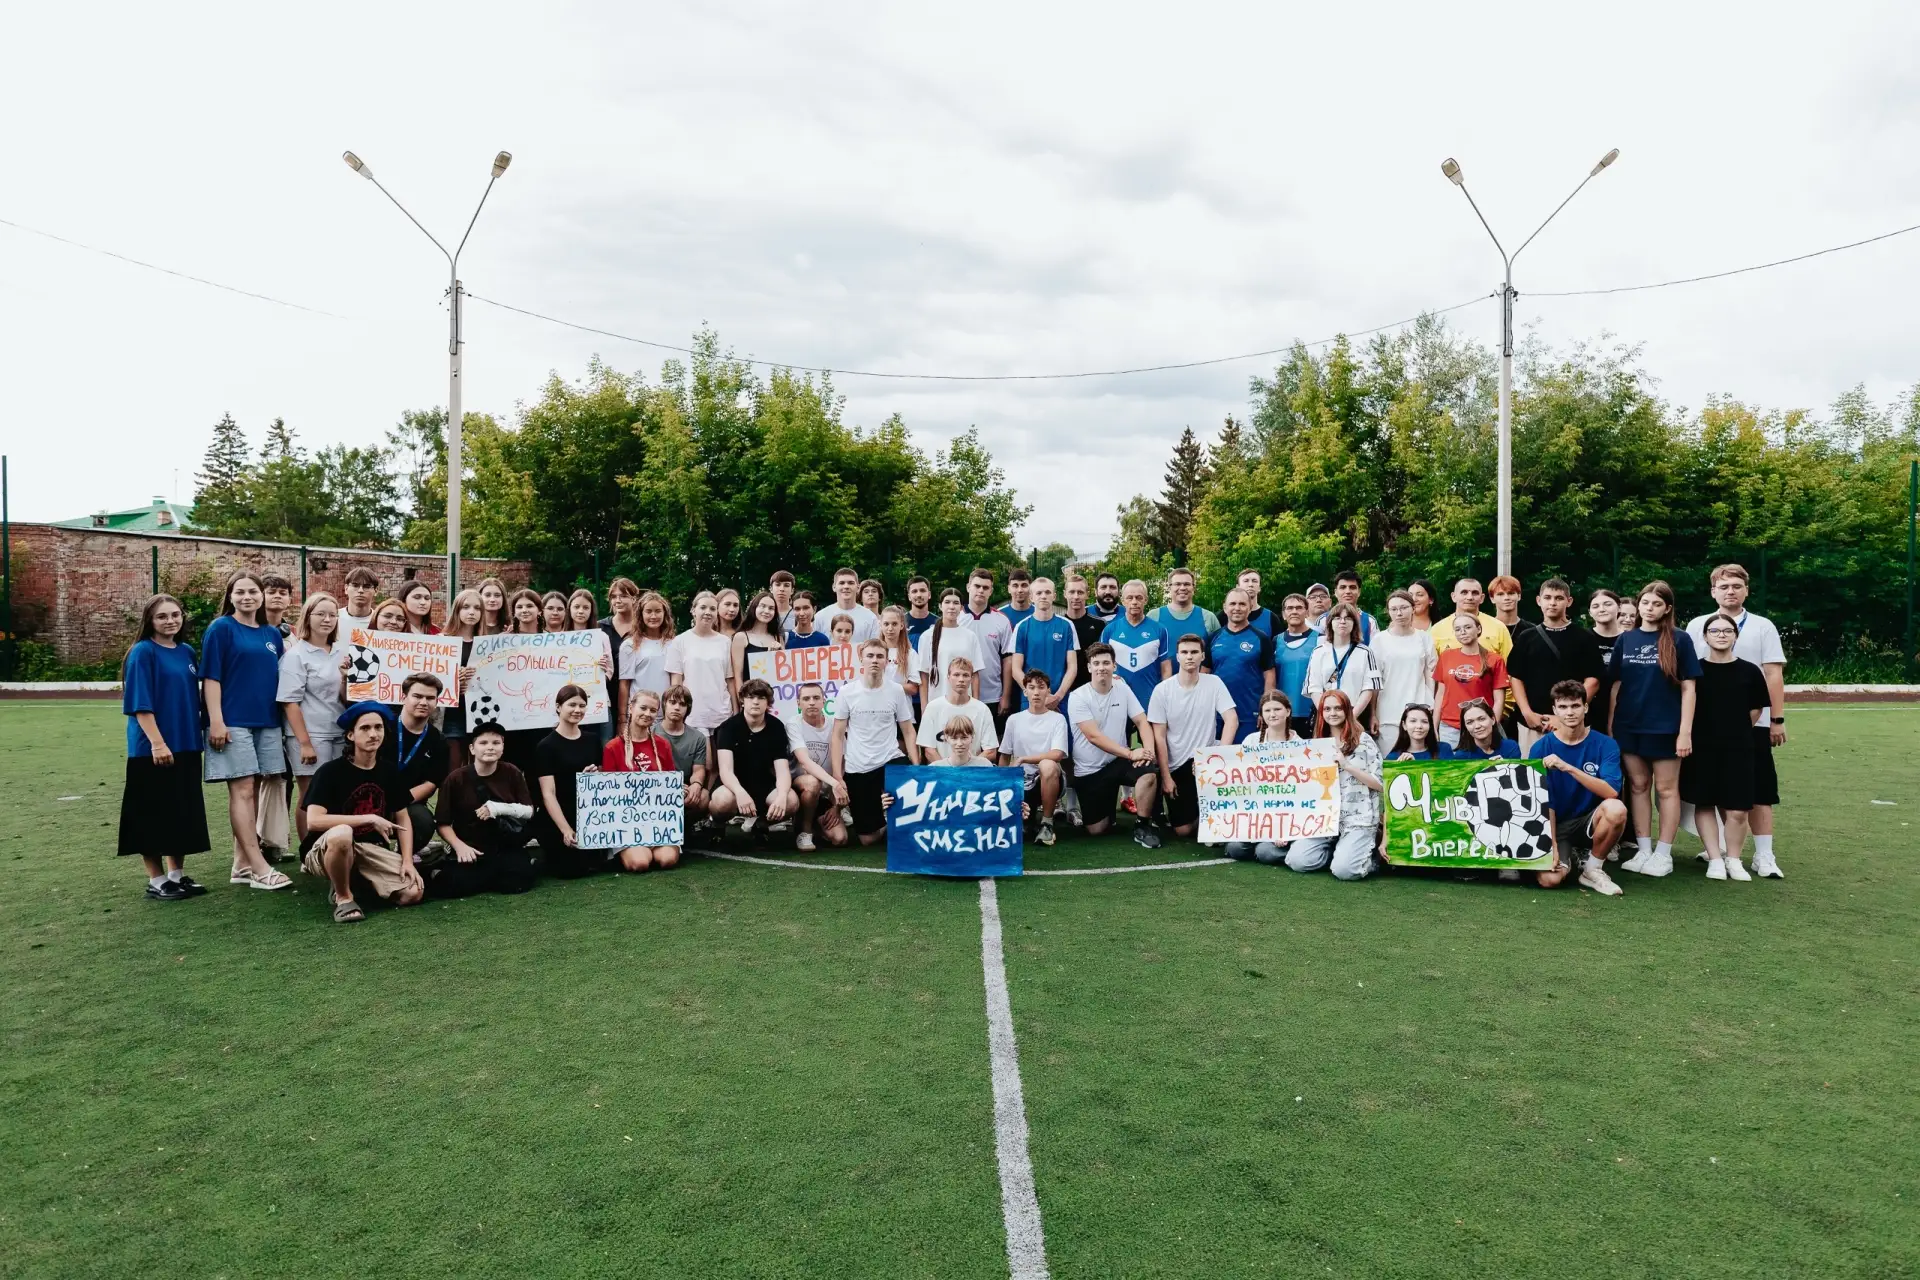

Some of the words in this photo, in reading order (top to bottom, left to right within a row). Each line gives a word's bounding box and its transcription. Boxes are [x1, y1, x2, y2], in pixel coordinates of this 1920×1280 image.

[387, 653, 449, 675] СМЕНЫ
[1130, 653, 1137, 667] 5
[1207, 755, 1243, 786] ЗА
[1246, 765, 1311, 783] ПОБЕДУ
[1323, 770, 1330, 780] 1
[579, 775, 620, 796] Пусть
[624, 773, 661, 797] будет
[1217, 786, 1252, 797] БУДЕМ
[1256, 784, 1297, 796] ДРАТЬСЯ
[655, 792, 684, 808] пас
[1210, 800, 1238, 811] ВАМ
[1243, 799, 1259, 811] ЗА
[1263, 799, 1295, 809] НАМИ
[1301, 799, 1316, 809] НЕ
[913, 825, 1017, 854] СМЕНЫ
